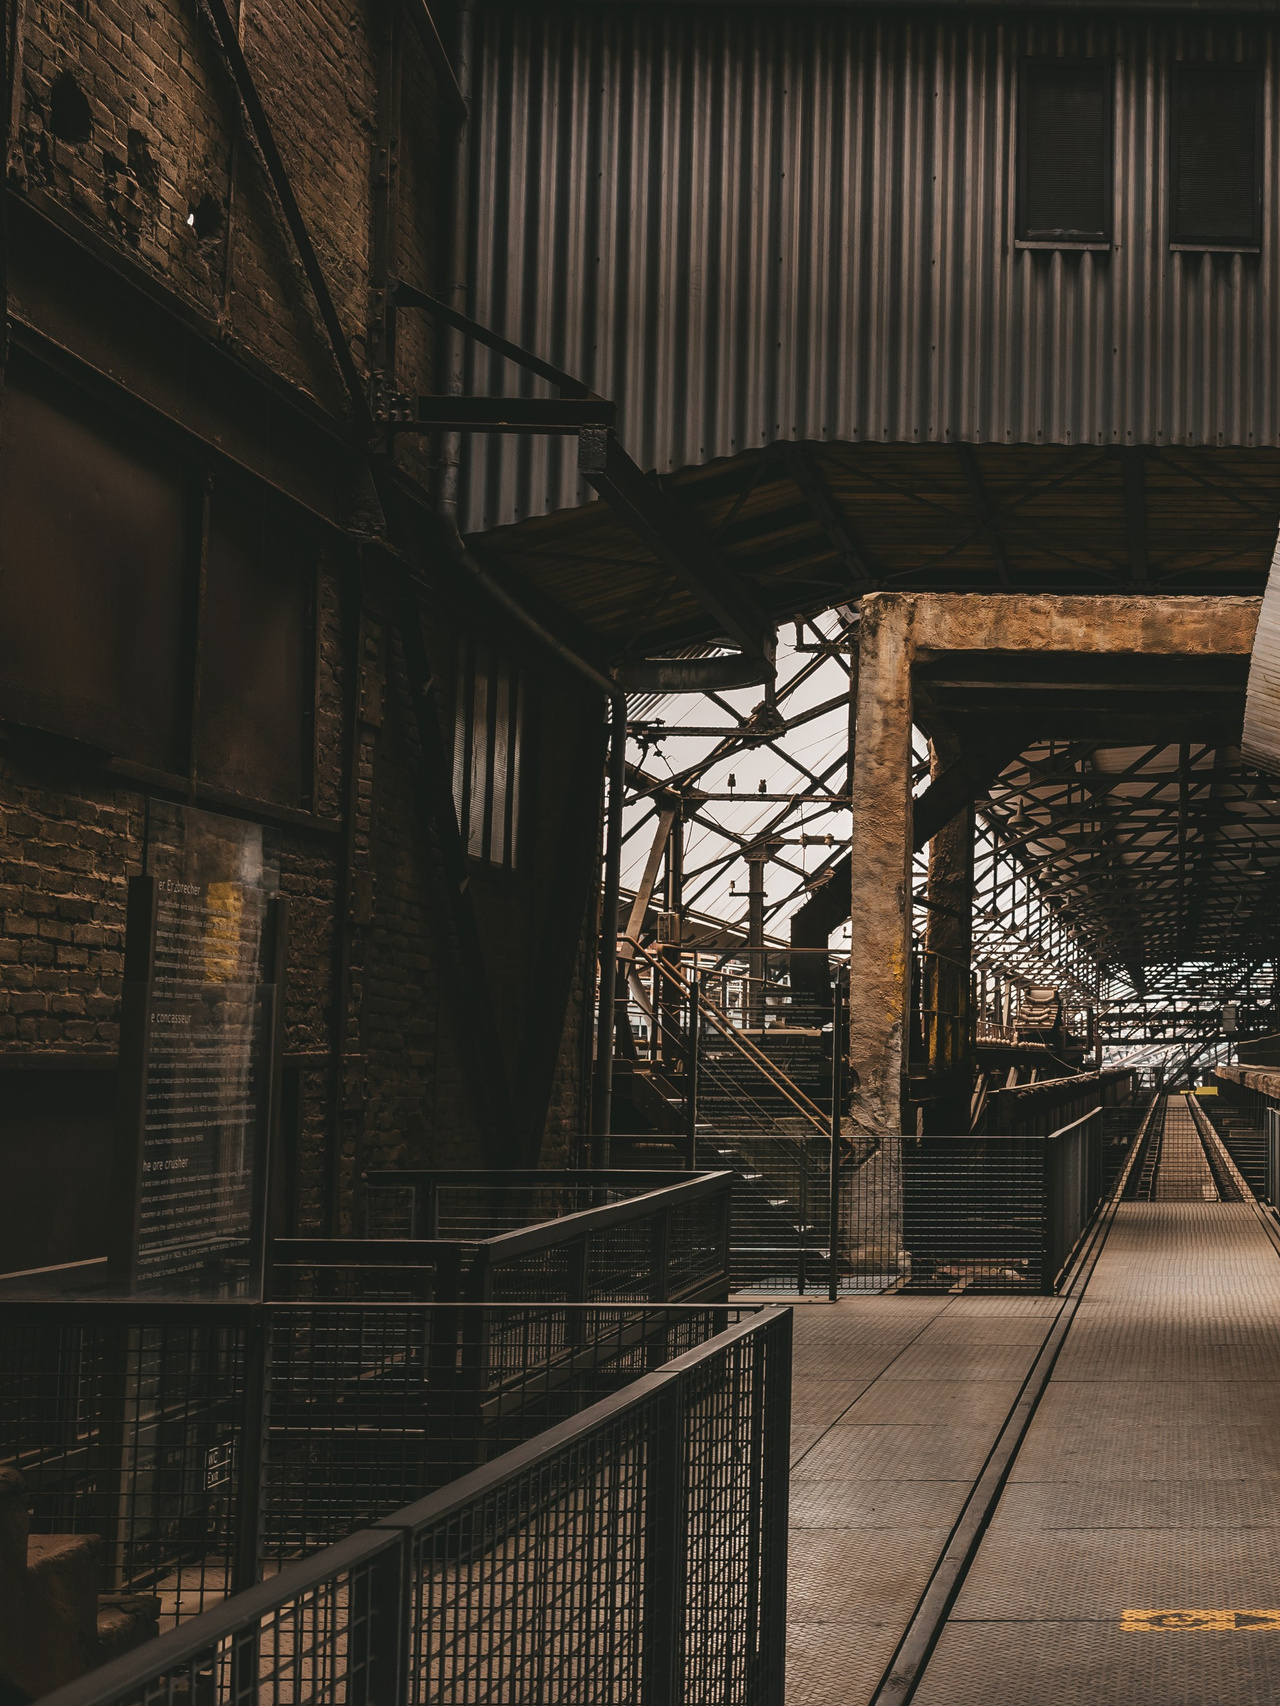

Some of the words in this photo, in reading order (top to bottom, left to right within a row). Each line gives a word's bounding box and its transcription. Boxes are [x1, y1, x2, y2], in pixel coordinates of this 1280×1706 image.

[167, 880, 200, 896] Erzbrecher
[150, 1013, 154, 1023] e
[157, 1014, 192, 1024] concasseur
[143, 1160, 151, 1172] he
[152, 1162, 163, 1171] ore
[165, 1157, 188, 1169] crusher
[207, 1471, 219, 1484] Exit
